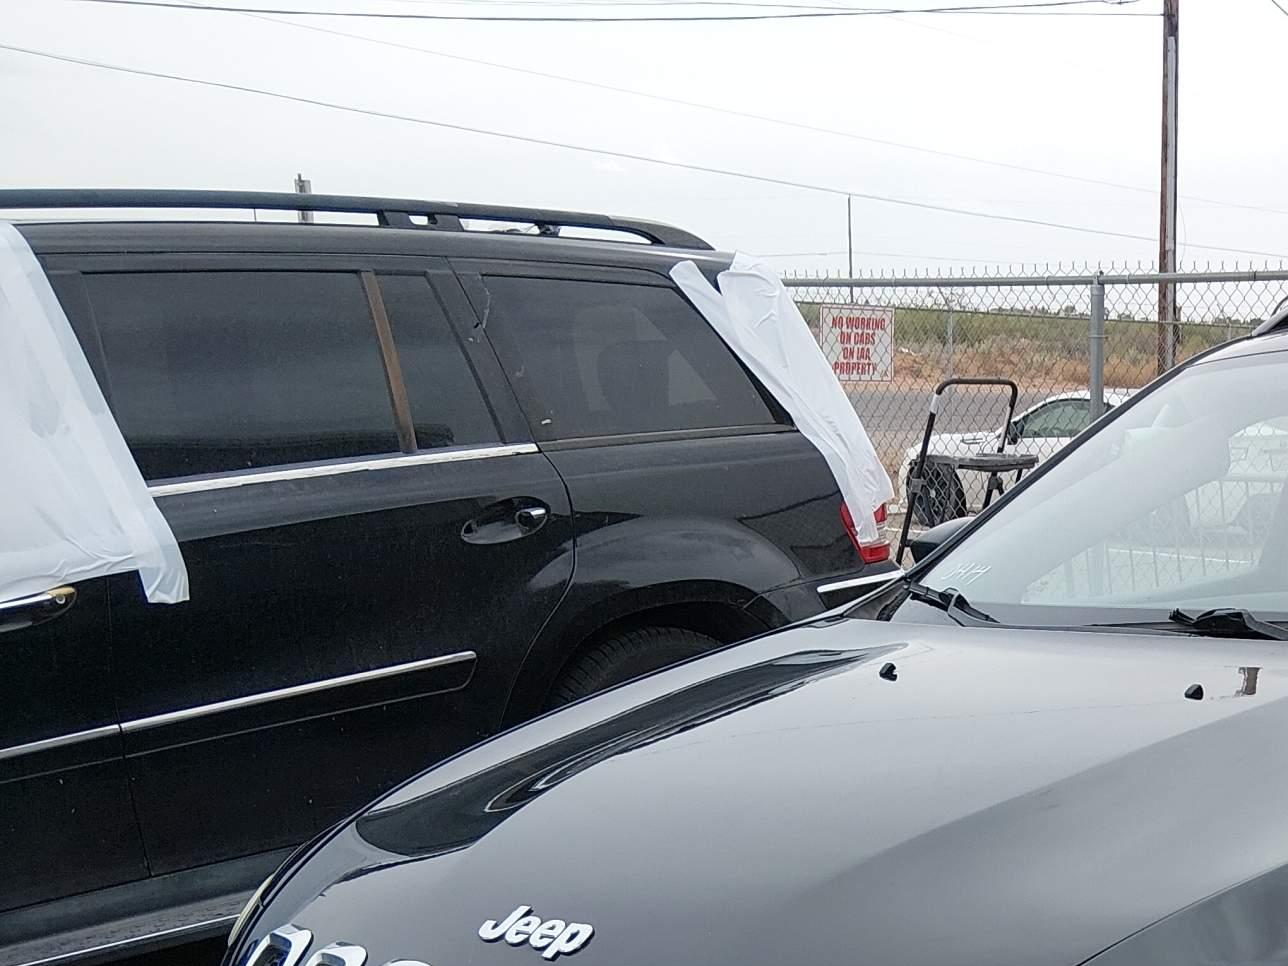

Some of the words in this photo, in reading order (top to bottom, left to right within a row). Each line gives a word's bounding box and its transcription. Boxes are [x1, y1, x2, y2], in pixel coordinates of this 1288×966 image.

[832, 316, 843, 329] NO
[846, 316, 886, 330] WORKING
[840, 331, 852, 345] ON
[842, 347, 854, 360] ON
[834, 361, 877, 375] PROPERTY
[478, 905, 595, 961] Jeep
